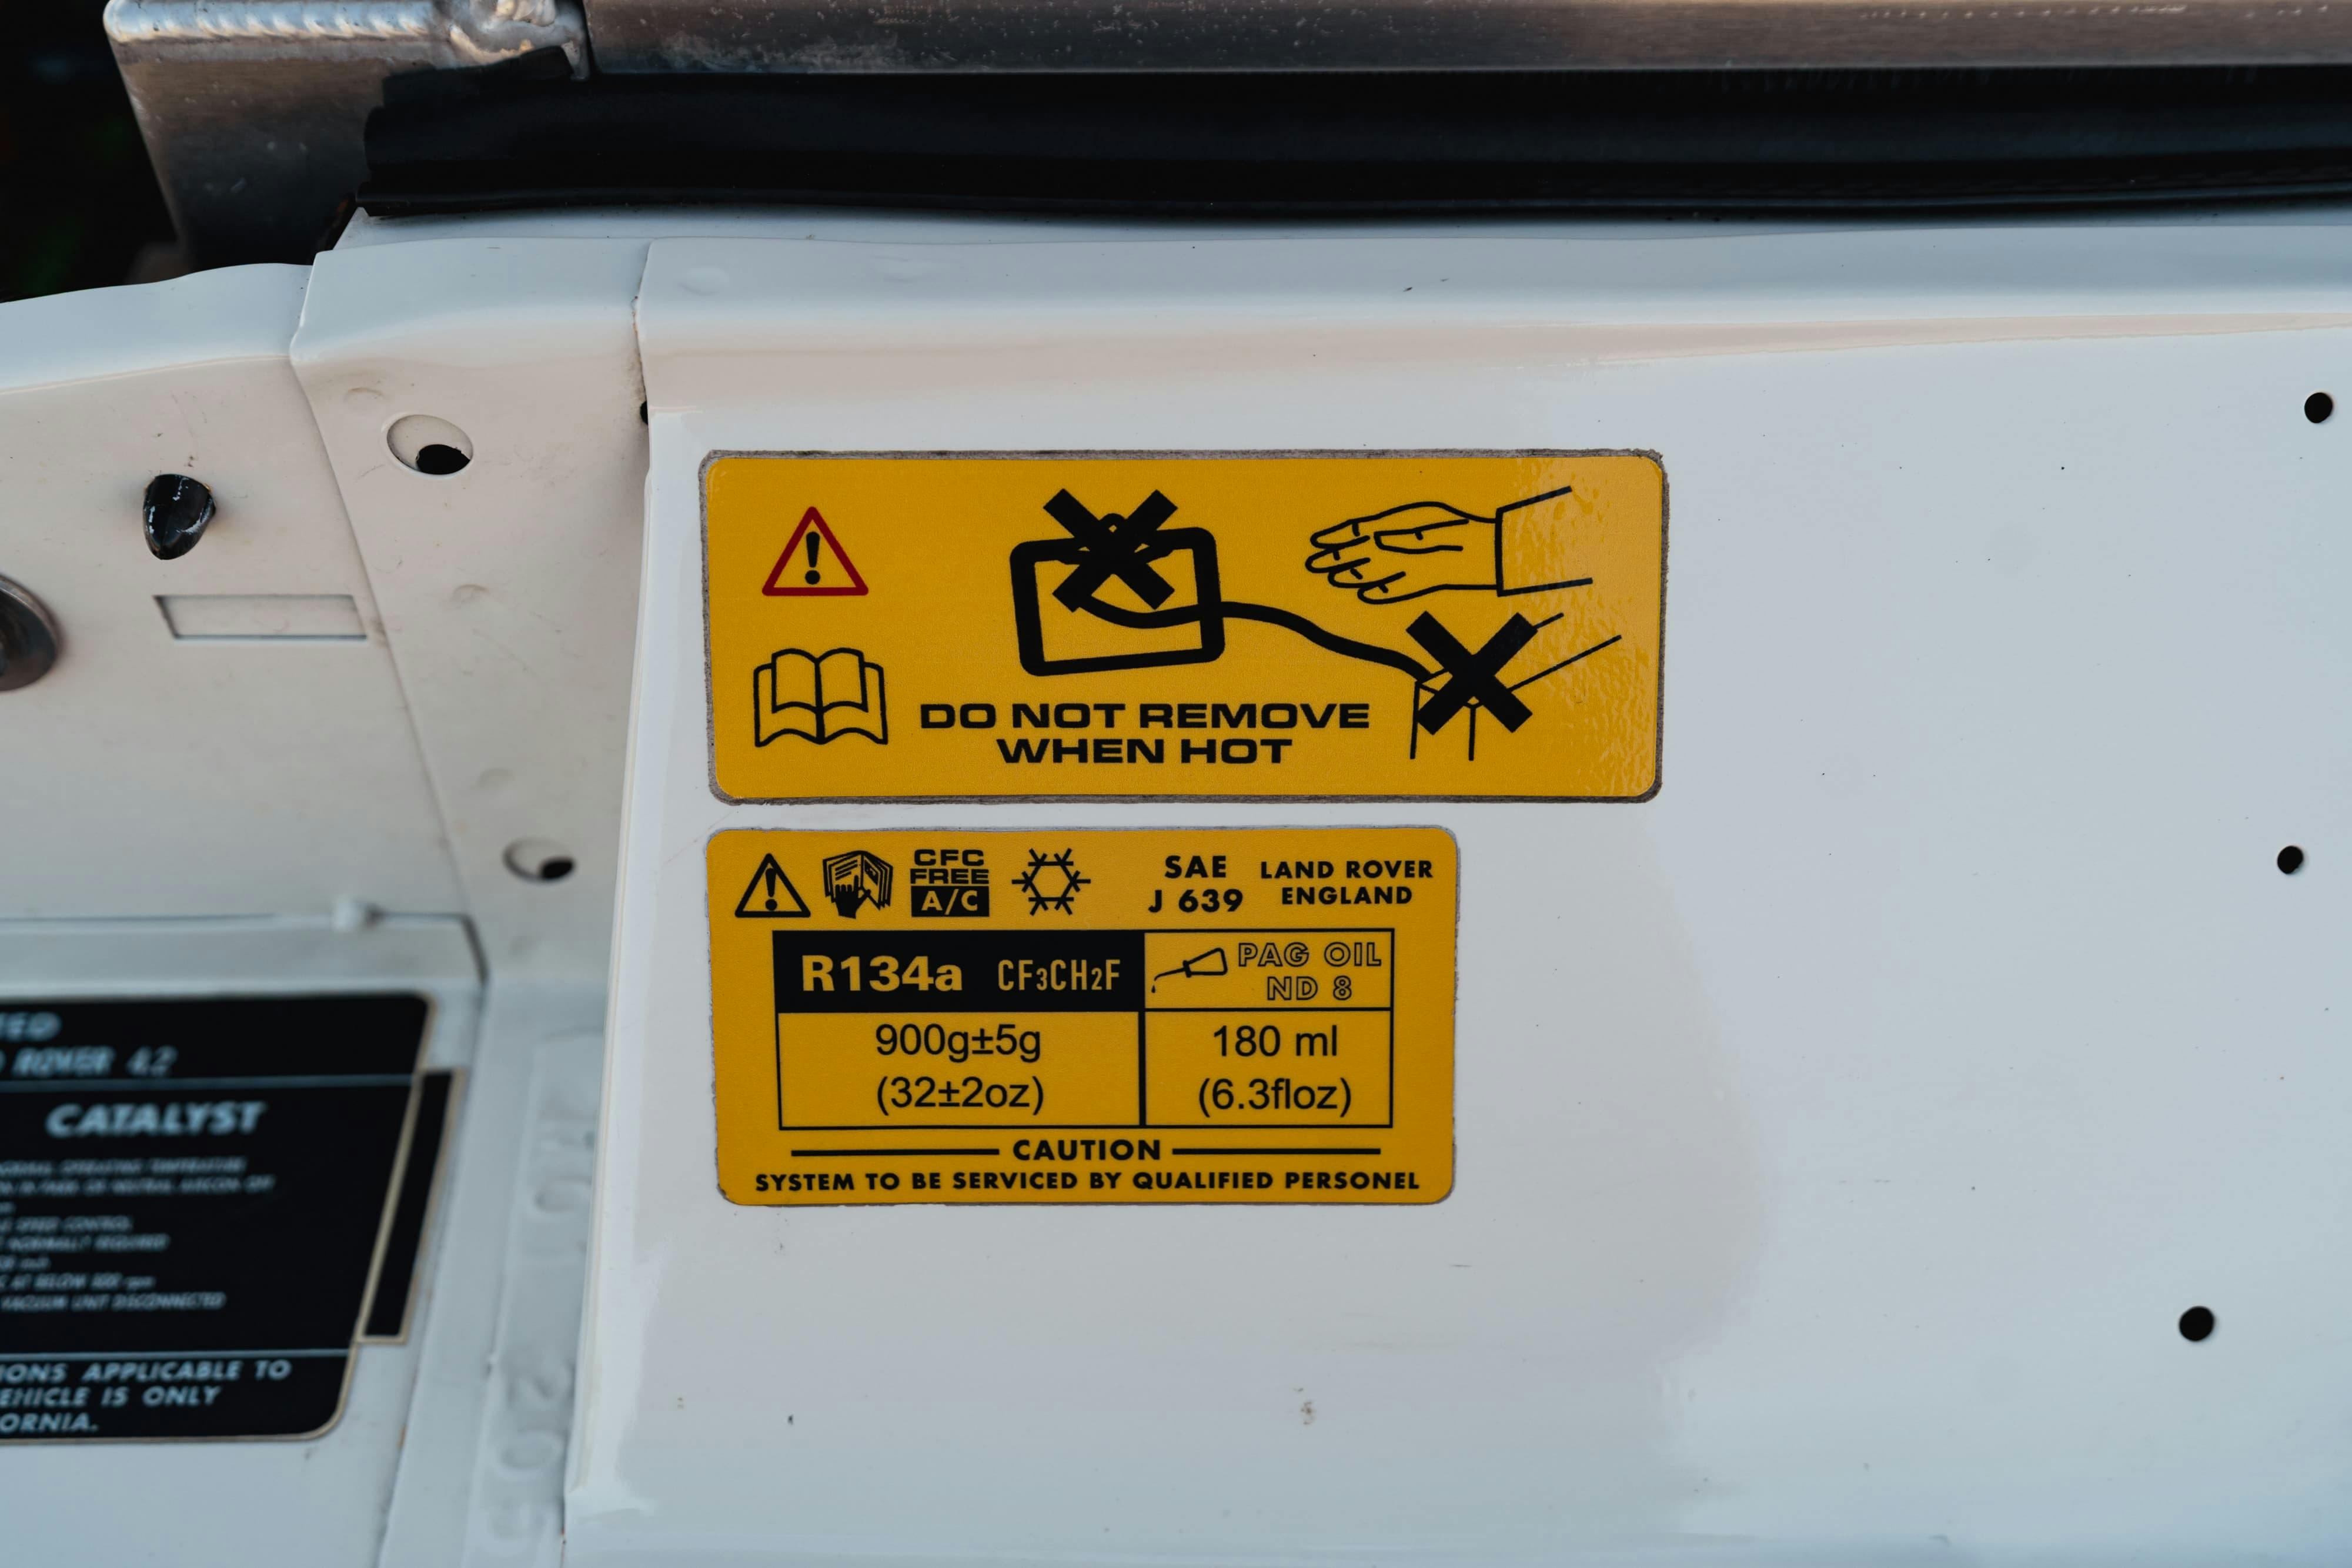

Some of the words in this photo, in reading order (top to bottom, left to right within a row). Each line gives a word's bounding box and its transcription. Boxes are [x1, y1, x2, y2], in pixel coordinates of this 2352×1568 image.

[921, 704, 996, 728] DO
[1013, 703, 1125, 728] NOT
[1140, 703, 1369, 728] REMOVE
[997, 739, 1164, 763] WHEN
[1181, 738, 1292, 764] HOT
[914, 849, 984, 866] CFC
[1165, 855, 1226, 878] SAE
[1261, 861, 1334, 878] LAND
[1347, 860, 1432, 878] ROVER
[910, 868, 989, 884] FREE
[922, 889, 977, 914] A/C
[1148, 890, 1162, 912] J
[1179, 889, 1242, 912] 639
[1282, 887, 1412, 904] ENGLAND
[1239, 942, 1309, 967] PAG
[1324, 942, 1382, 967] OIL
[803, 955, 962, 991] R134a
[1267, 976, 1318, 1001] ND
[1333, 975, 1352, 1001] 8
[876, 1024, 1040, 1062] 900g±5g
[1214, 1025, 1280, 1057] 180
[1296, 1025, 1337, 1056] ml
[878, 1076, 1043, 1115] (32±2oz)
[1200, 1078, 1351, 1117] (6.3floz)
[46, 1102, 263, 1136] CATALYST
[1013, 1139, 1160, 1161] CAUTION
[756, 1174, 854, 1191] SYSTEM
[866, 1173, 900, 1190] TO
[913, 1173, 940, 1189] BE
[953, 1172, 1077, 1189] SERVICED
[1090, 1172, 1121, 1189] BY
[1133, 1172, 1272, 1189] QUALIFIED
[1286, 1172, 1419, 1189] PERSONEL
[83, 1361, 240, 1381] APPLICABLE
[255, 1360, 291, 1380] TO
[102, 1387, 127, 1406] IS
[143, 1386, 219, 1405] ONLY
